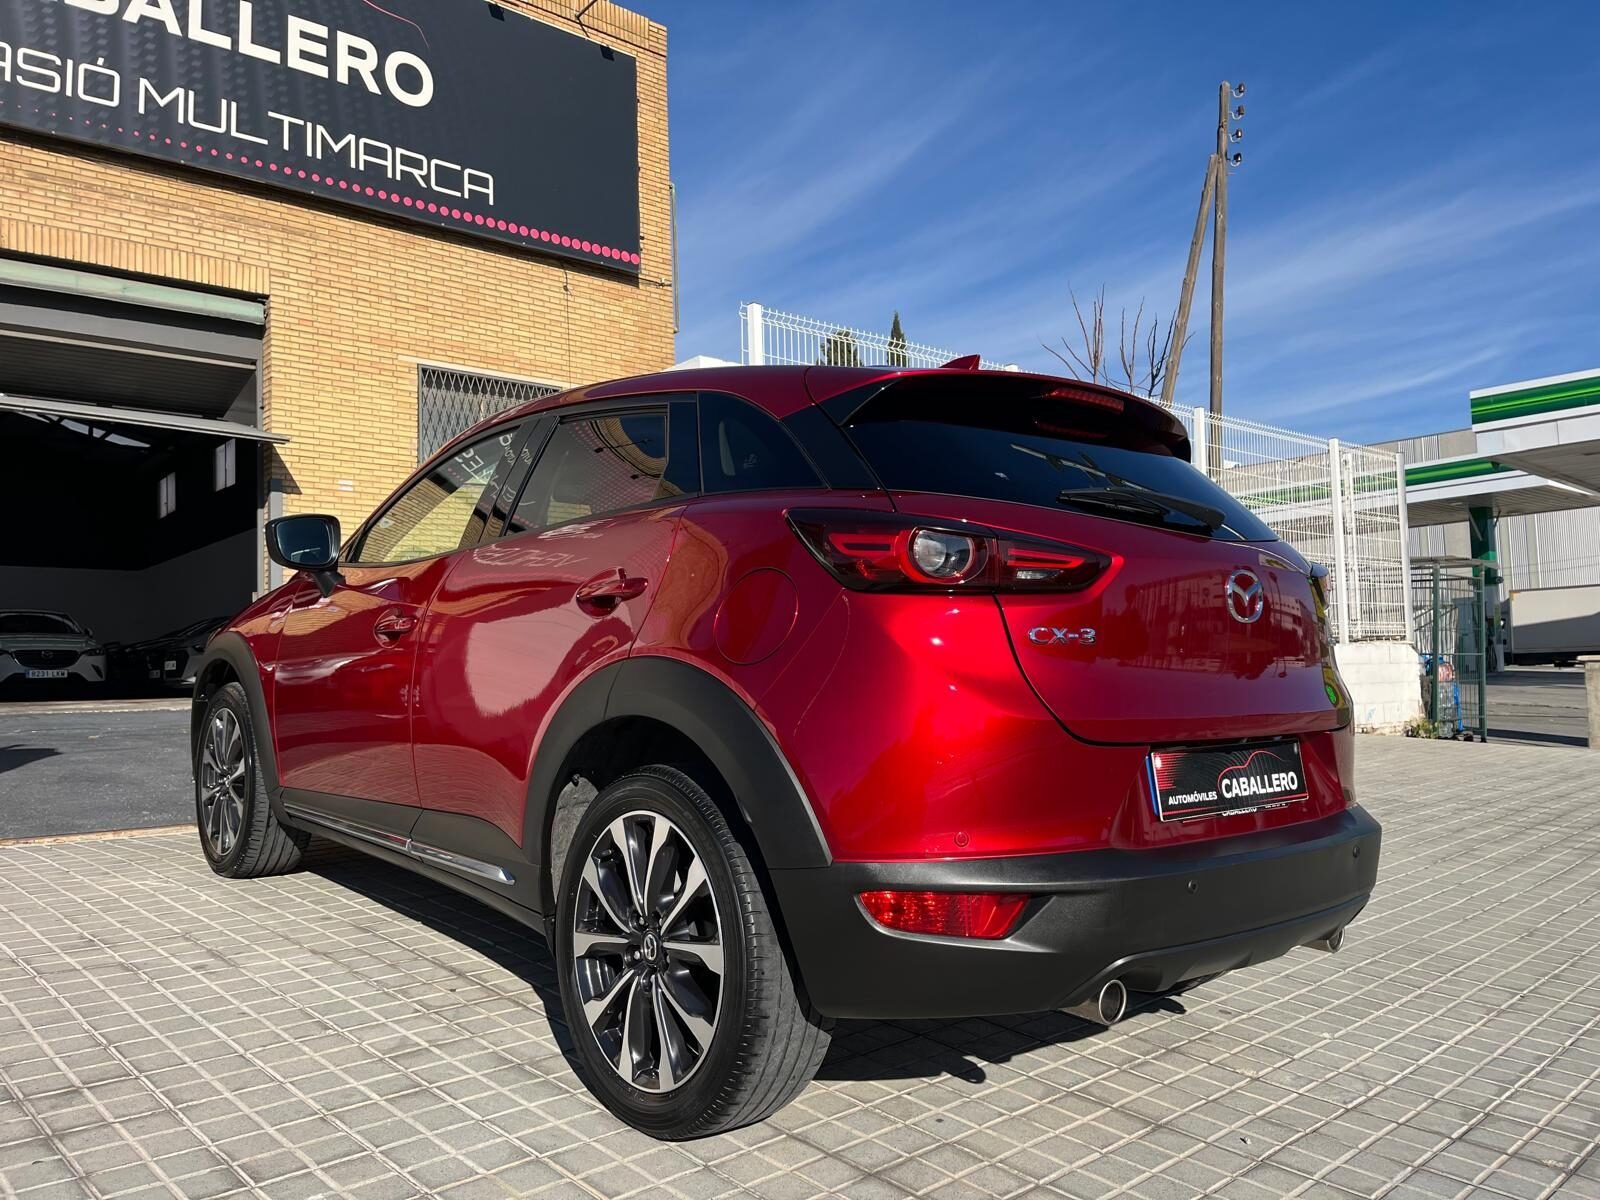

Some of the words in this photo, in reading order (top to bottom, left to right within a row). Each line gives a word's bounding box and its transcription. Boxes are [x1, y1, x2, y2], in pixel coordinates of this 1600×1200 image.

[64, 0, 434, 107] ALLERO
[0, 41, 121, 107] SIÓ
[138, 77, 494, 205] MULTIMARCA
[1028, 627, 1097, 645] CX-3
[1168, 791, 1218, 805] AUTOMÓVILES
[1221, 772, 1298, 798] CABALLERO
